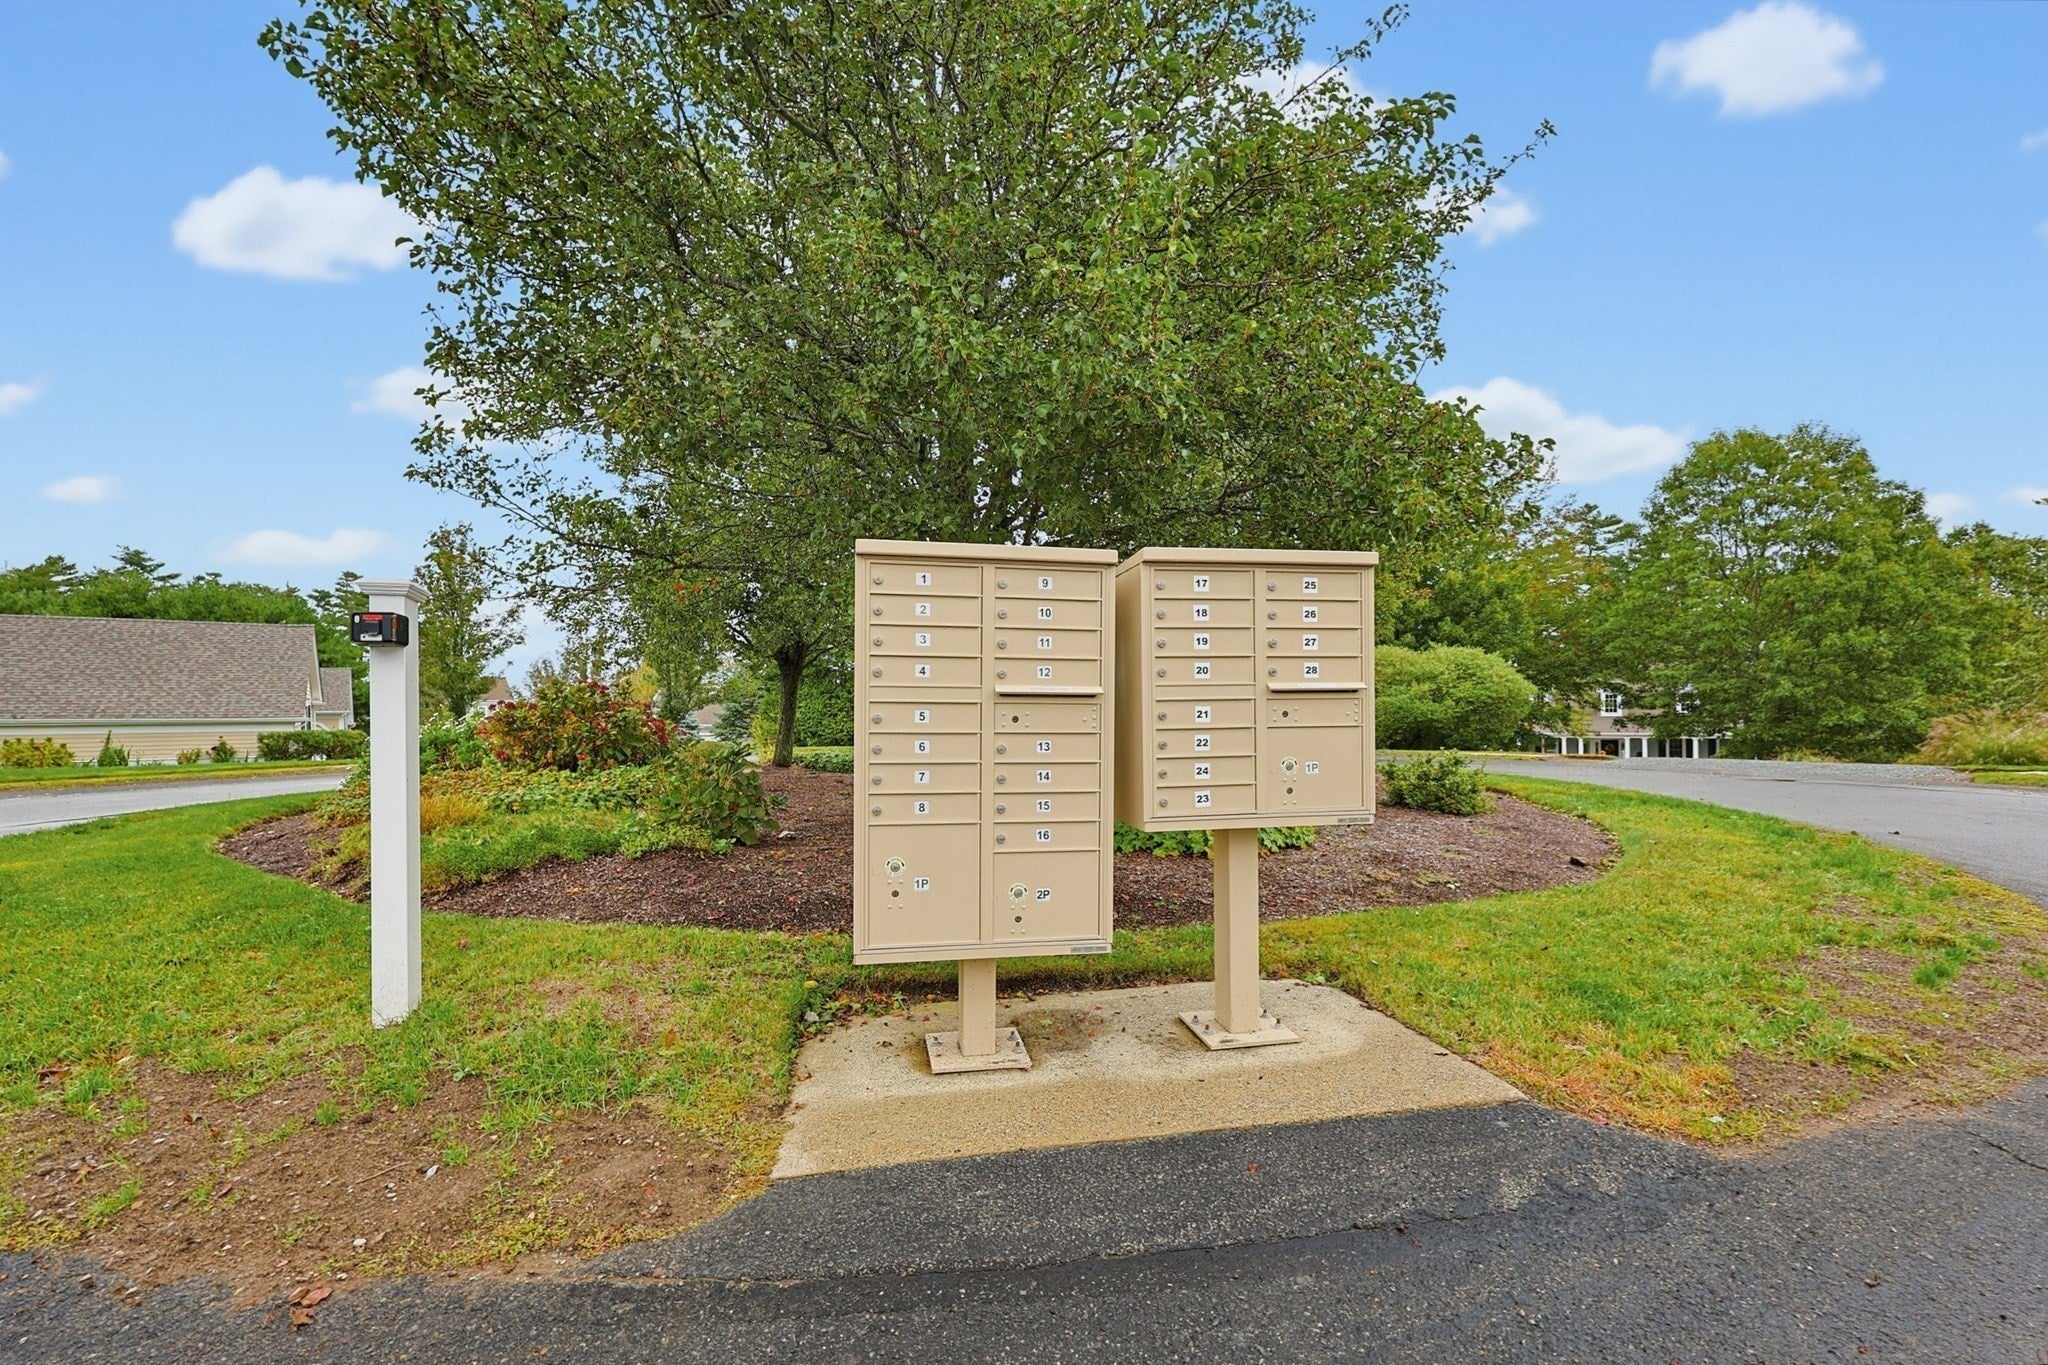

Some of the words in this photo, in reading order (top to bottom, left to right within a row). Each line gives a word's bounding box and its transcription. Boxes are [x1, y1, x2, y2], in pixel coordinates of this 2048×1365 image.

[1041, 578, 1049, 588] 9
[1195, 579, 1208, 588] 17
[1304, 581, 1317, 590] 25
[920, 604, 927, 615] 2
[1039, 608, 1052, 618] 10
[1195, 608, 1208, 618] 18
[1304, 610, 1317, 619] 26
[920, 634, 927, 644] 3
[1039, 638, 1050, 648] 11
[1196, 637, 1208, 646] 19
[1304, 637, 1317, 647] 27
[918, 666, 926, 676] 4
[1038, 667, 1051, 677] 12
[1196, 666, 1209, 675] 20
[1305, 665, 1318, 675] 28
[919, 711, 926, 722] 5
[1196, 709, 1209, 719] 21
[918, 741, 926, 752] 6
[1038, 741, 1051, 752] 13
[1195, 738, 1209, 747] 22
[1196, 766, 1209, 776] 24
[1306, 763, 1318, 772] 1P
[918, 772, 926, 782] 7
[1037, 771, 1050, 782] 14
[1196, 794, 1210, 804] 23
[918, 802, 926, 813] 8
[1037, 800, 1050, 811] 15
[1037, 830, 1050, 840] 16
[915, 878, 929, 889] 1P
[1036, 889, 1050, 900] 2P
